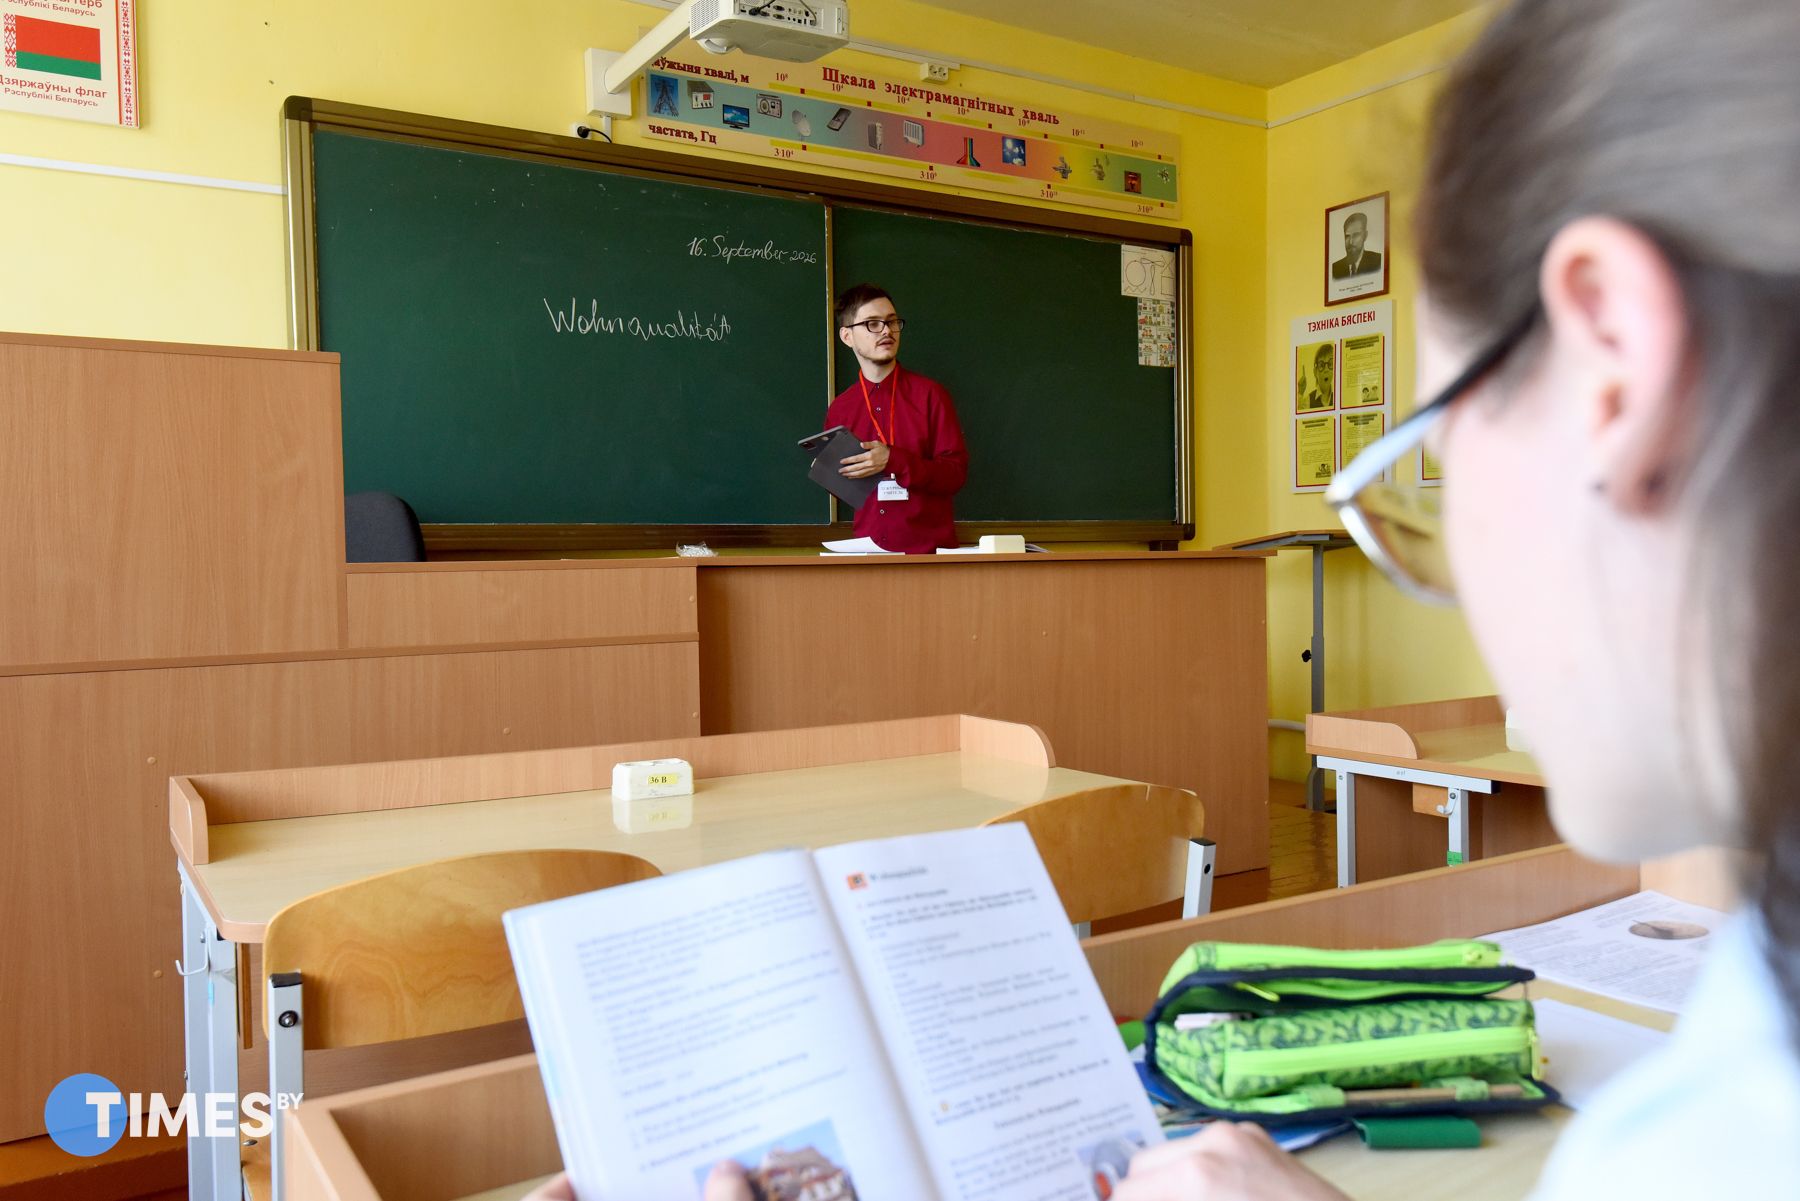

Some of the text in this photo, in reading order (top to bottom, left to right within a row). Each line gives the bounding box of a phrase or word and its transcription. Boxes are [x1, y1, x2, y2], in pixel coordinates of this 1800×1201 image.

[52, 3, 96, 17] Беларусь
[651, 56, 750, 84] аўжыня хвалі, м
[4, 87, 99, 107] Рэспублікі Беларусь
[75, 85, 109, 99] флаг
[822, 66, 1061, 125] Шкала электрамагнітных хваль
[647, 123, 717, 145] частата, Гц
[687, 236, 707, 257] 16.
[711, 234, 787, 265] September
[1308, 310, 1376, 333] ТЭХНІКА БЯСПЕКІ
[650, 776, 659, 784] 36
